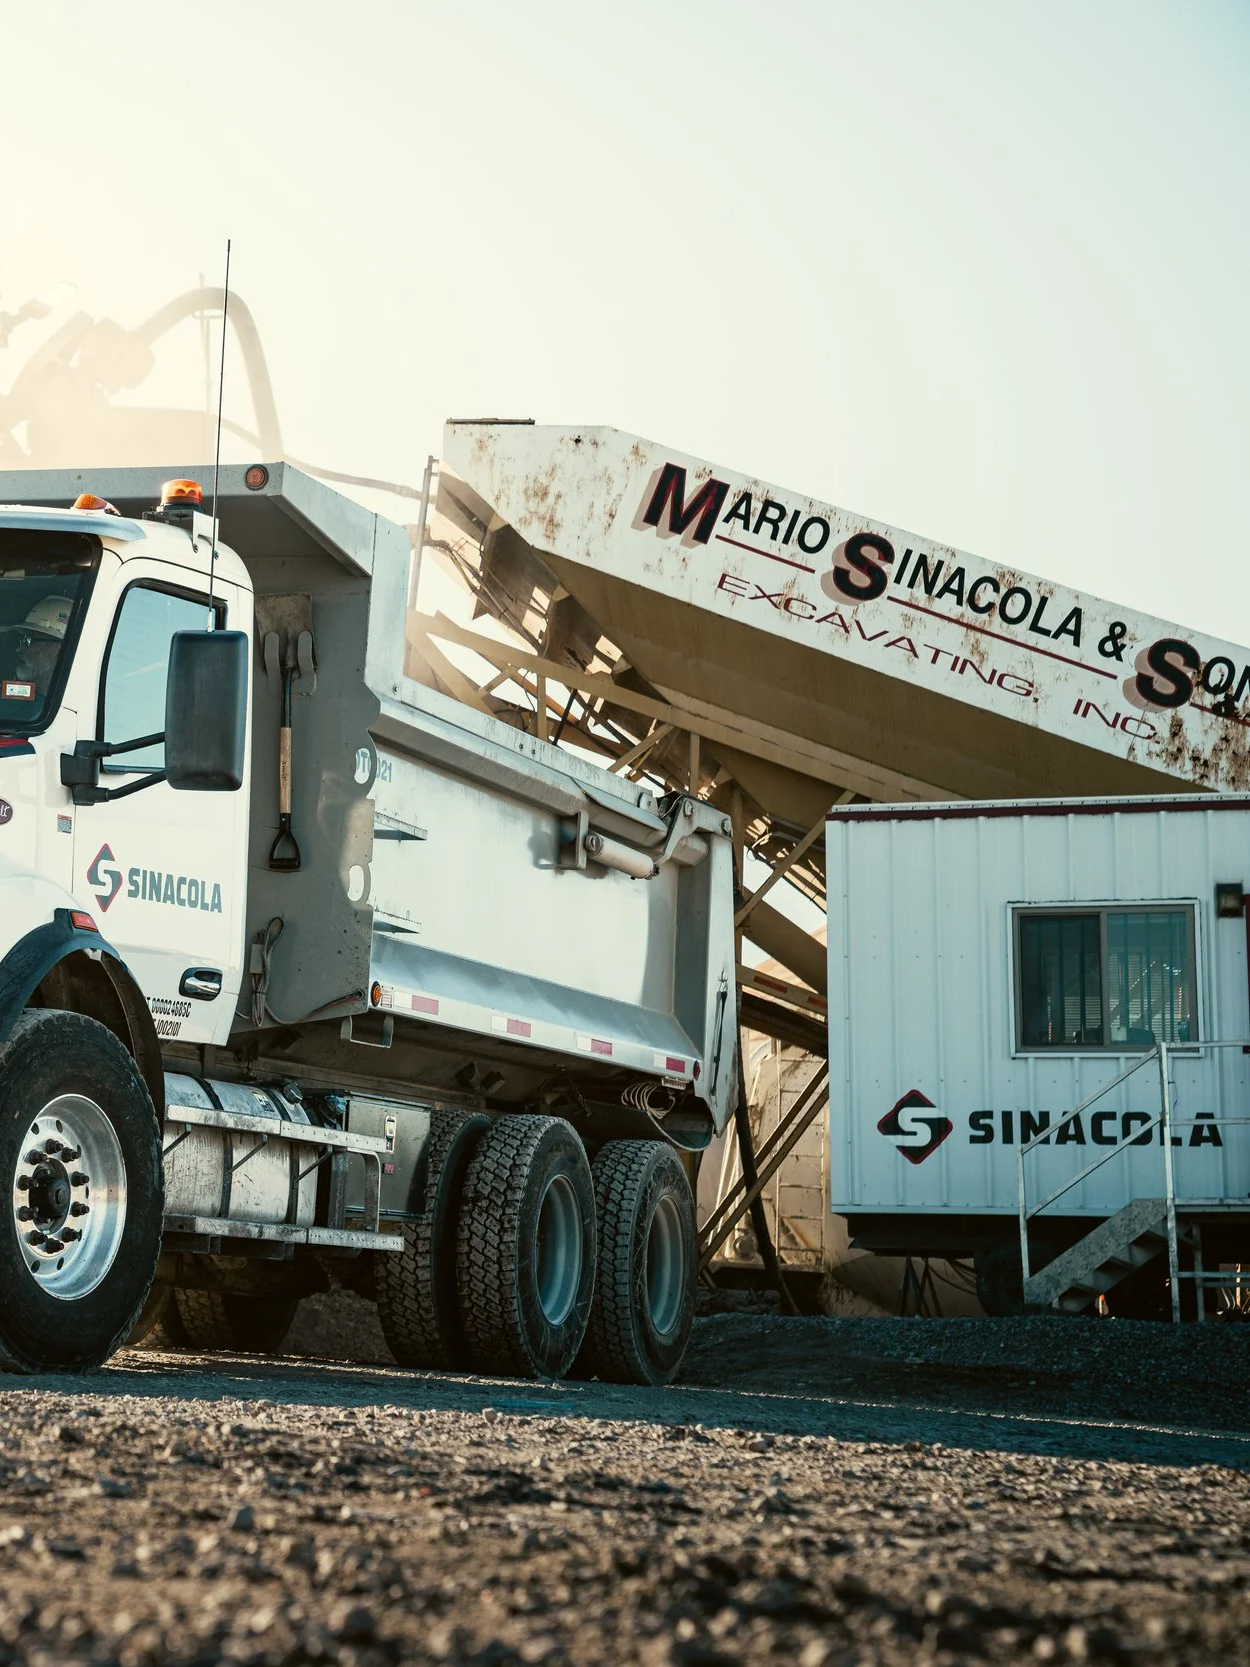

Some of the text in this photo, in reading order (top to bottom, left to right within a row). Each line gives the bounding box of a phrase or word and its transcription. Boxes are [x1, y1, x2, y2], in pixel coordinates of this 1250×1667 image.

[633, 462, 831, 554] MARIO
[822, 532, 1083, 648] SINACOLA
[1097, 621, 1128, 663] &
[1072, 698, 1161, 745] INC.
[127, 867, 223, 914] SINACOLA
